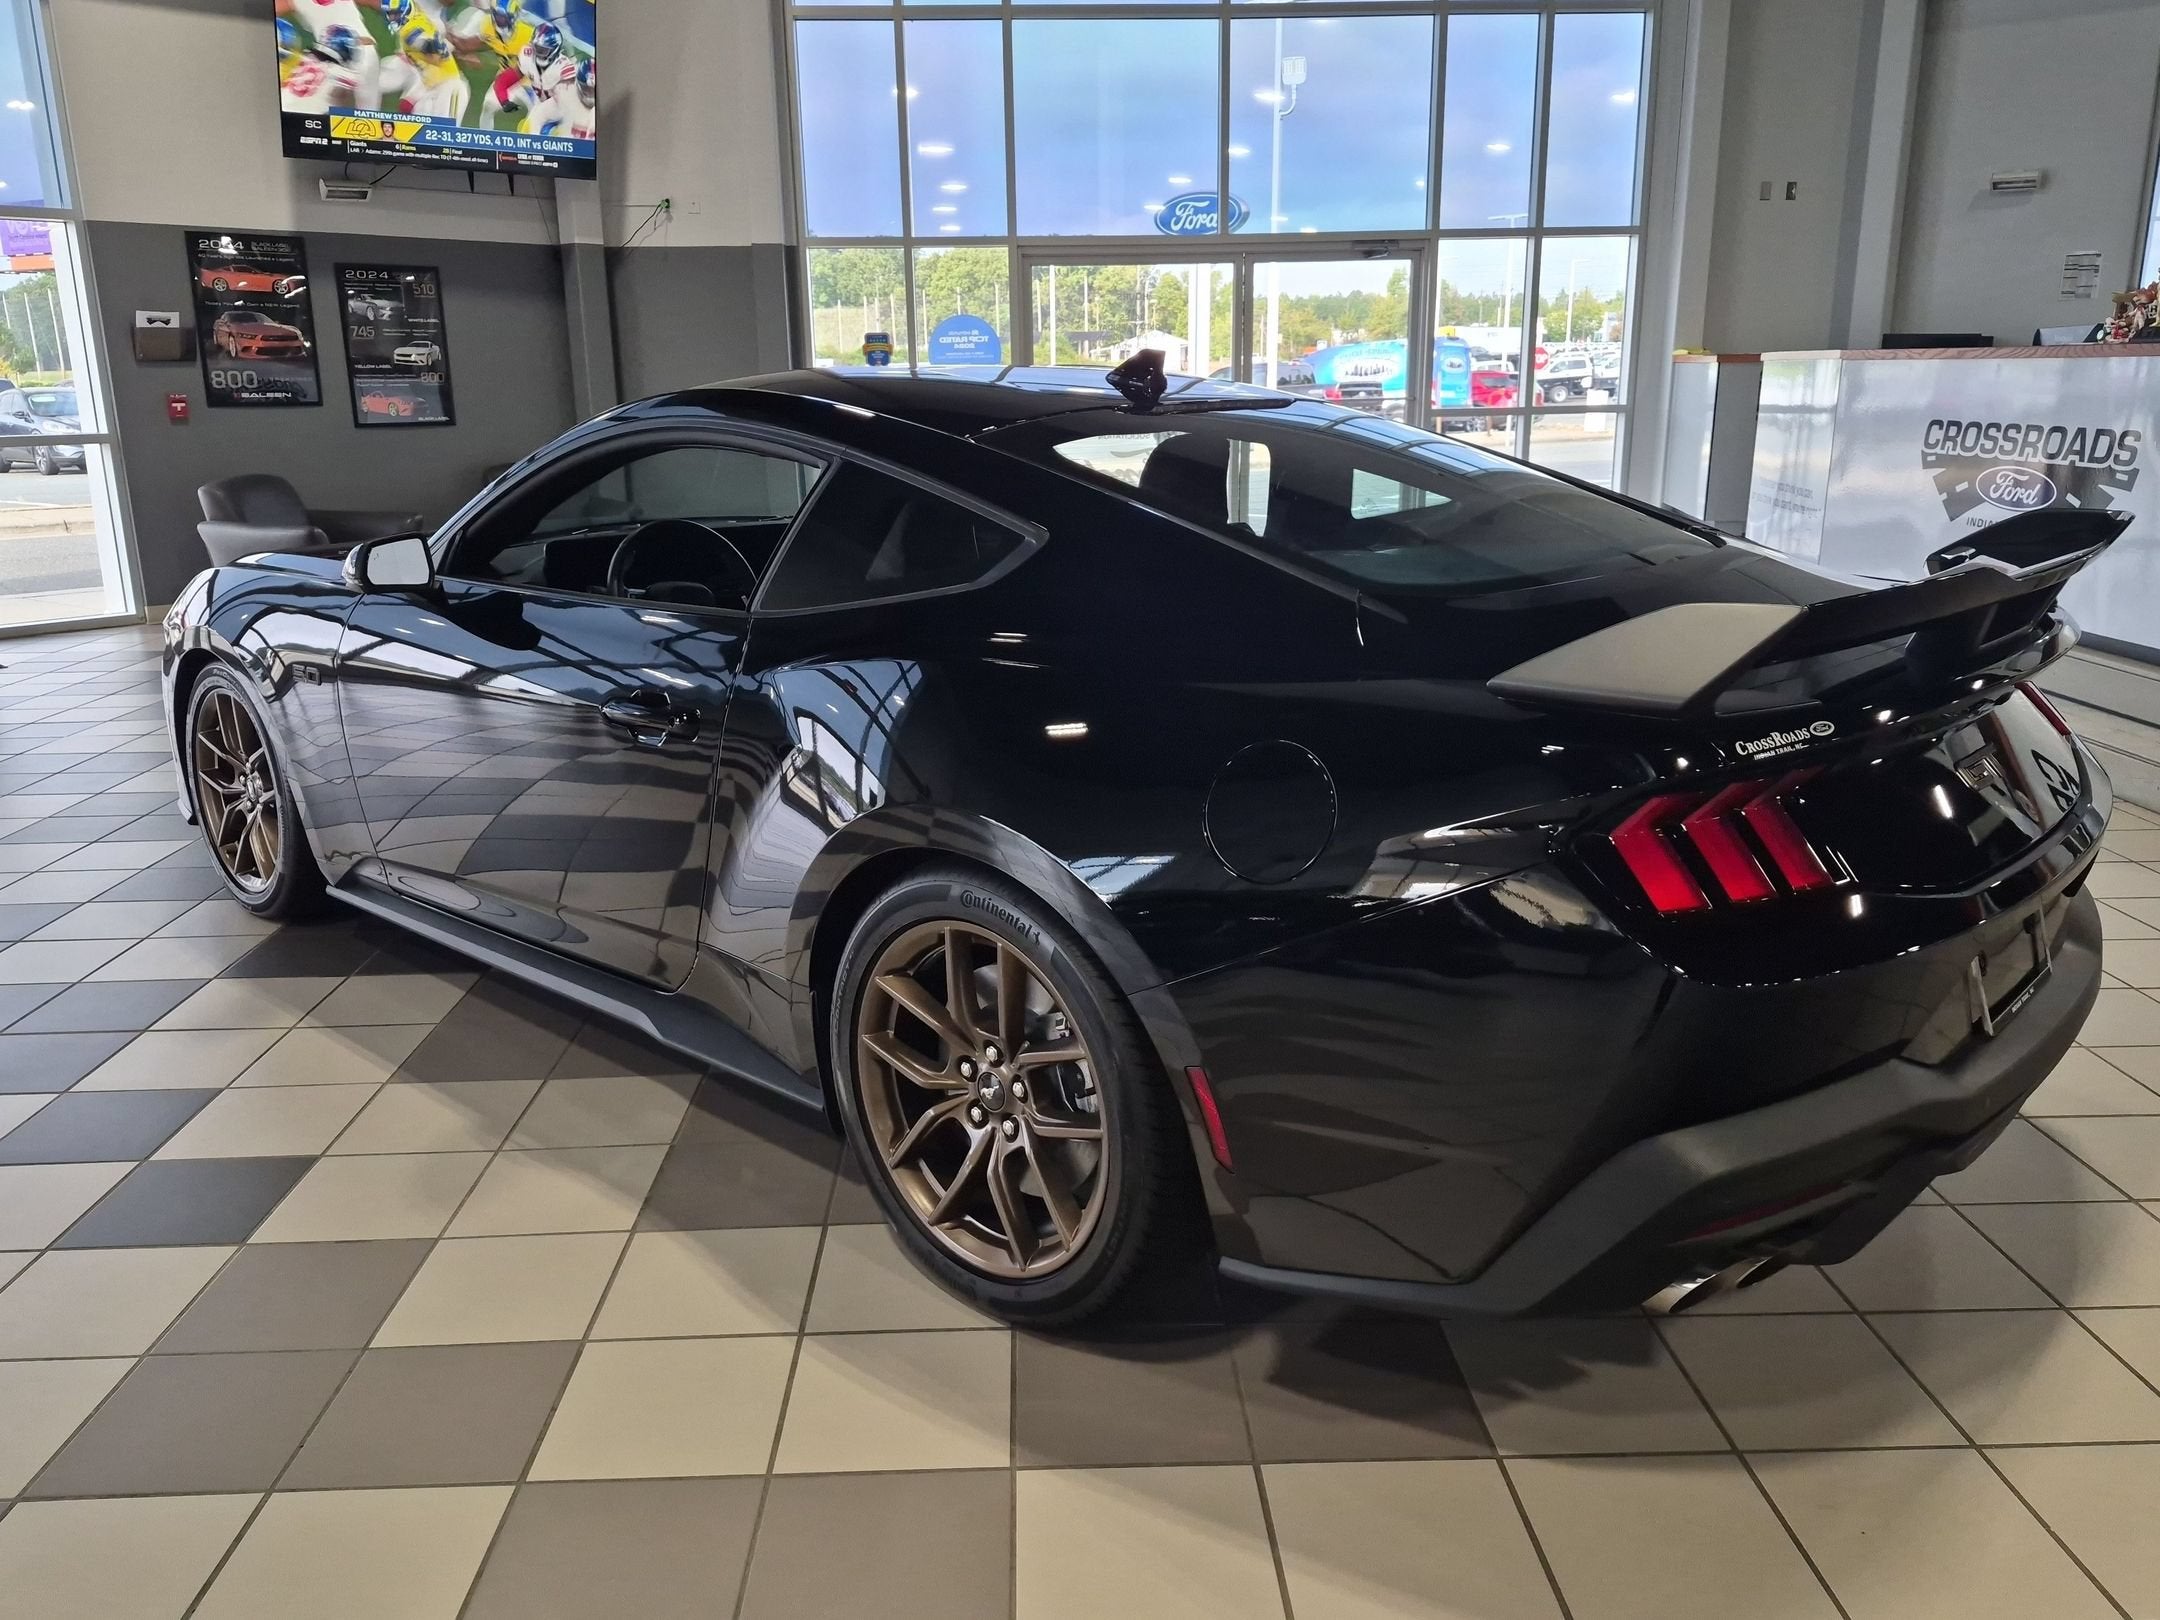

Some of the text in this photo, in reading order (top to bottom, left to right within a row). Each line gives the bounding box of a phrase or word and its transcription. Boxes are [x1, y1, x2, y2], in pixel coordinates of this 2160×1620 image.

[354, 110, 432, 123] MATTHEW STAFFORD
[305, 120, 322, 128] SC
[426, 130, 574, 152] 22-31, 327 YDS, 4 TD, INT vs GIANTS
[198, 240, 244, 250] 204
[345, 270, 388, 279] 2024
[412, 284, 435, 295] 510
[350, 326, 375, 337] 745
[211, 370, 258, 389] 800
[421, 372, 445, 383] 800
[1924, 419, 2142, 469] CROSSROADS
[1990, 472, 2041, 504] Ford
[1966, 516, 1995, 528] INDIA
[1754, 750, 1775, 760] INDIAN
[1775, 745, 1796, 756] TRAIL,
[961, 890, 1032, 938] Continental
